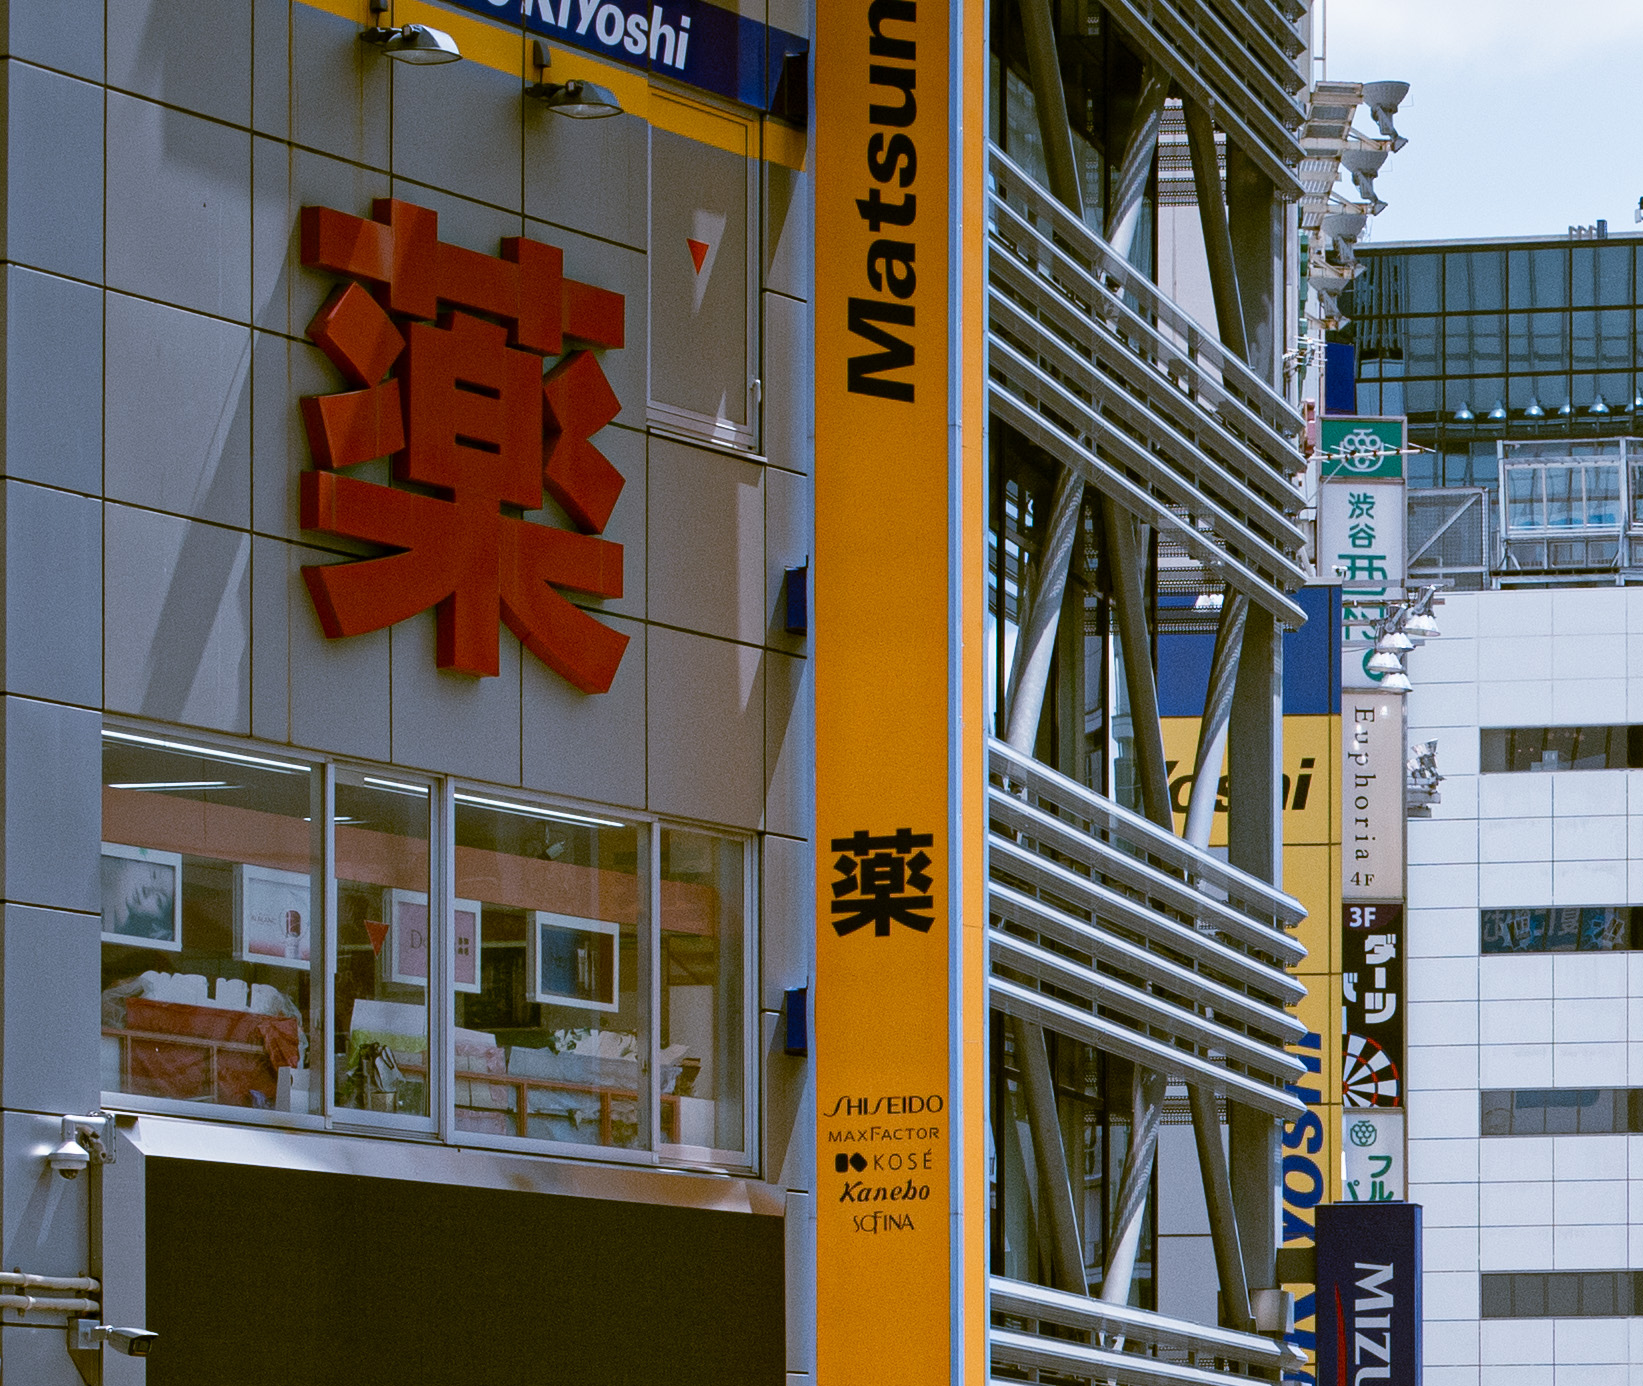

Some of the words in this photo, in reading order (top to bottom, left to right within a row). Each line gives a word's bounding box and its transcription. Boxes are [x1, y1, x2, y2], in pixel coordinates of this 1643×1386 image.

[301, 198, 630, 694] 薬
[1350, 706, 1376, 863] Euphoria
[829, 827, 936, 937] 薬
[1350, 871, 1375, 887] 4F
[1349, 906, 1376, 928] 3F
[1364, 933, 1397, 1024] ダーツ
[823, 1094, 944, 1118] SHISEIDO
[873, 1148, 933, 1170] KOSÉ
[839, 1179, 930, 1203] Kanebo
[853, 1211, 915, 1235] SOFINA
